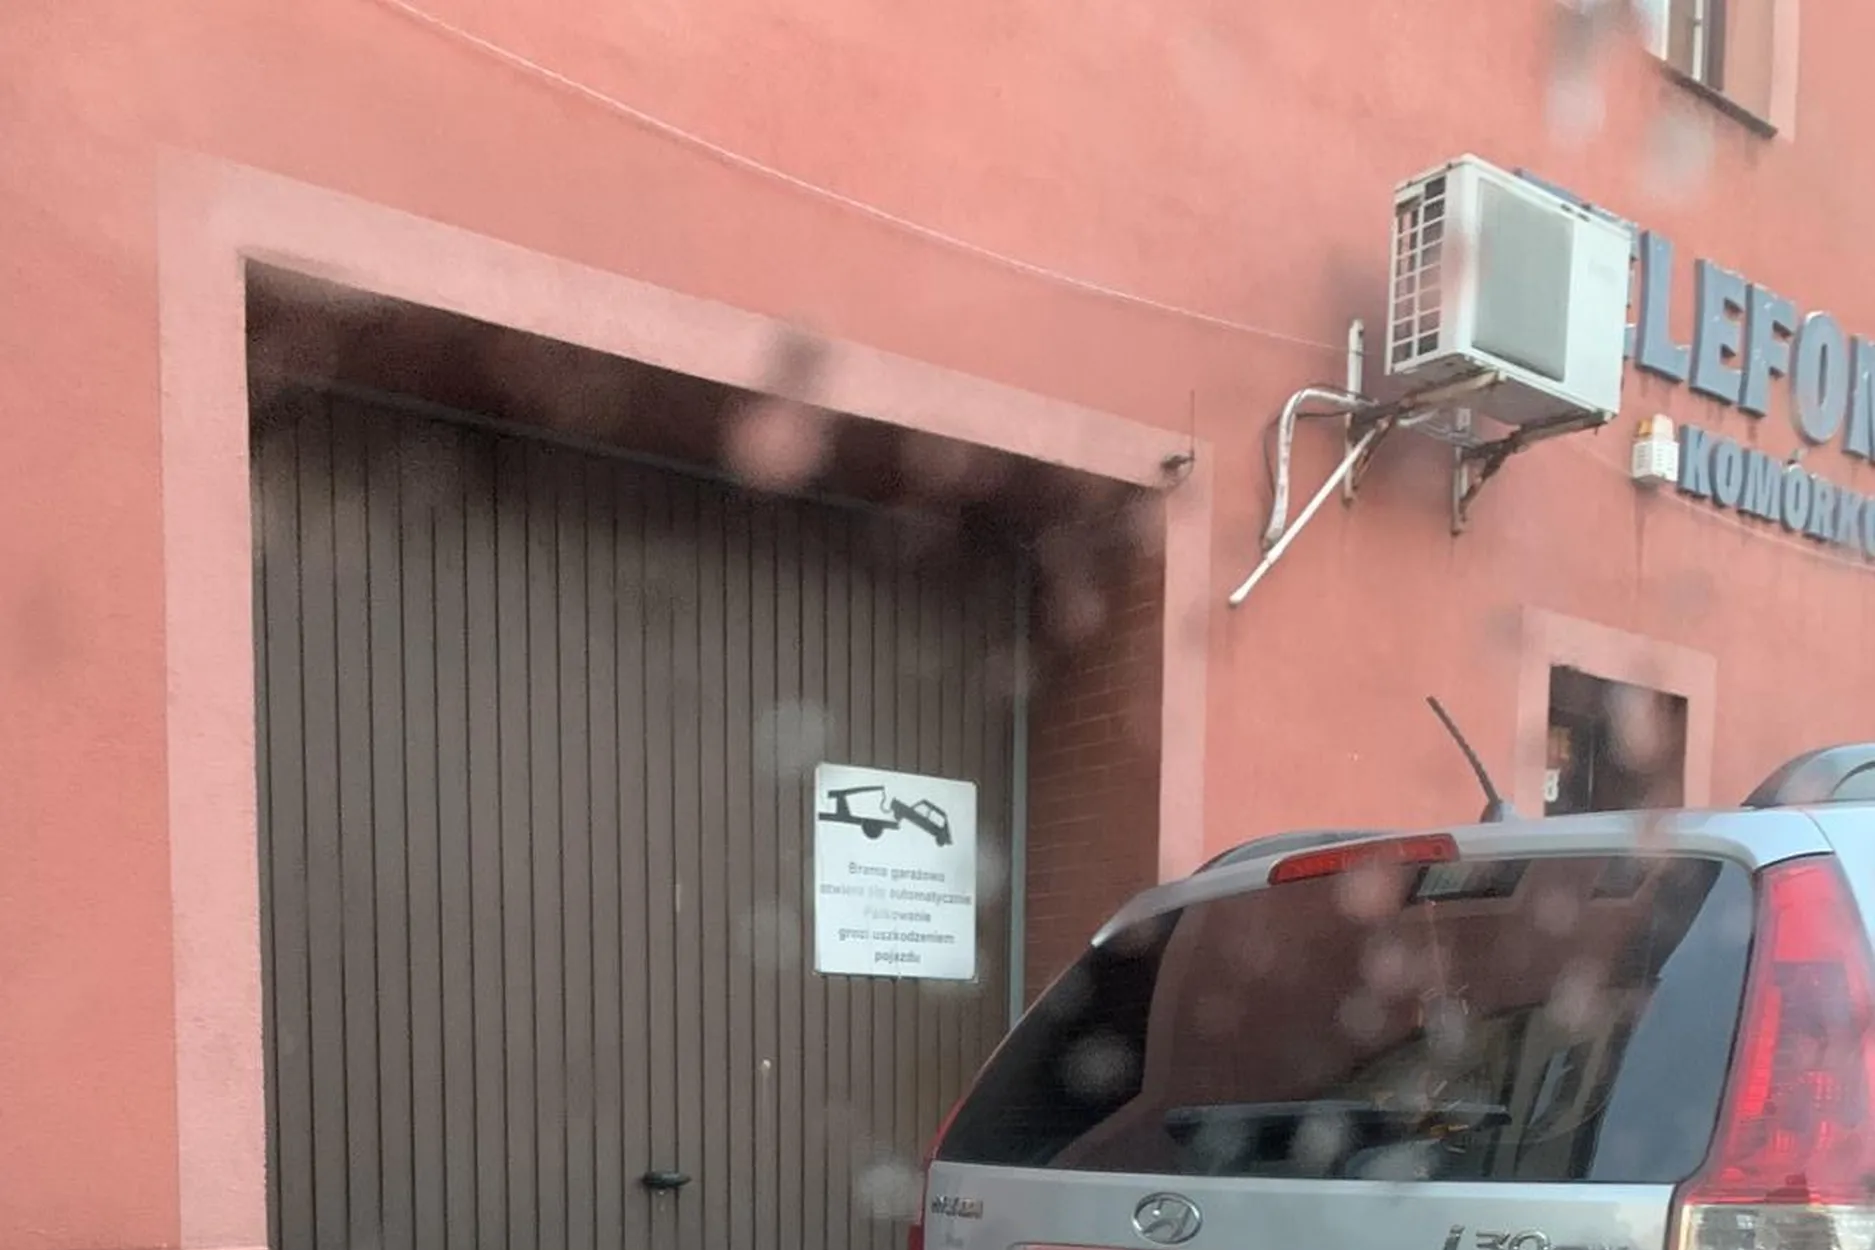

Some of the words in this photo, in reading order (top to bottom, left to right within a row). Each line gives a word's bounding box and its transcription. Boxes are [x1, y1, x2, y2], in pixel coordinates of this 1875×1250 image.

[1612, 226, 1875, 466] LEFO
[848, 861, 888, 877] Brama
[874, 950, 921, 965] pojazdu
